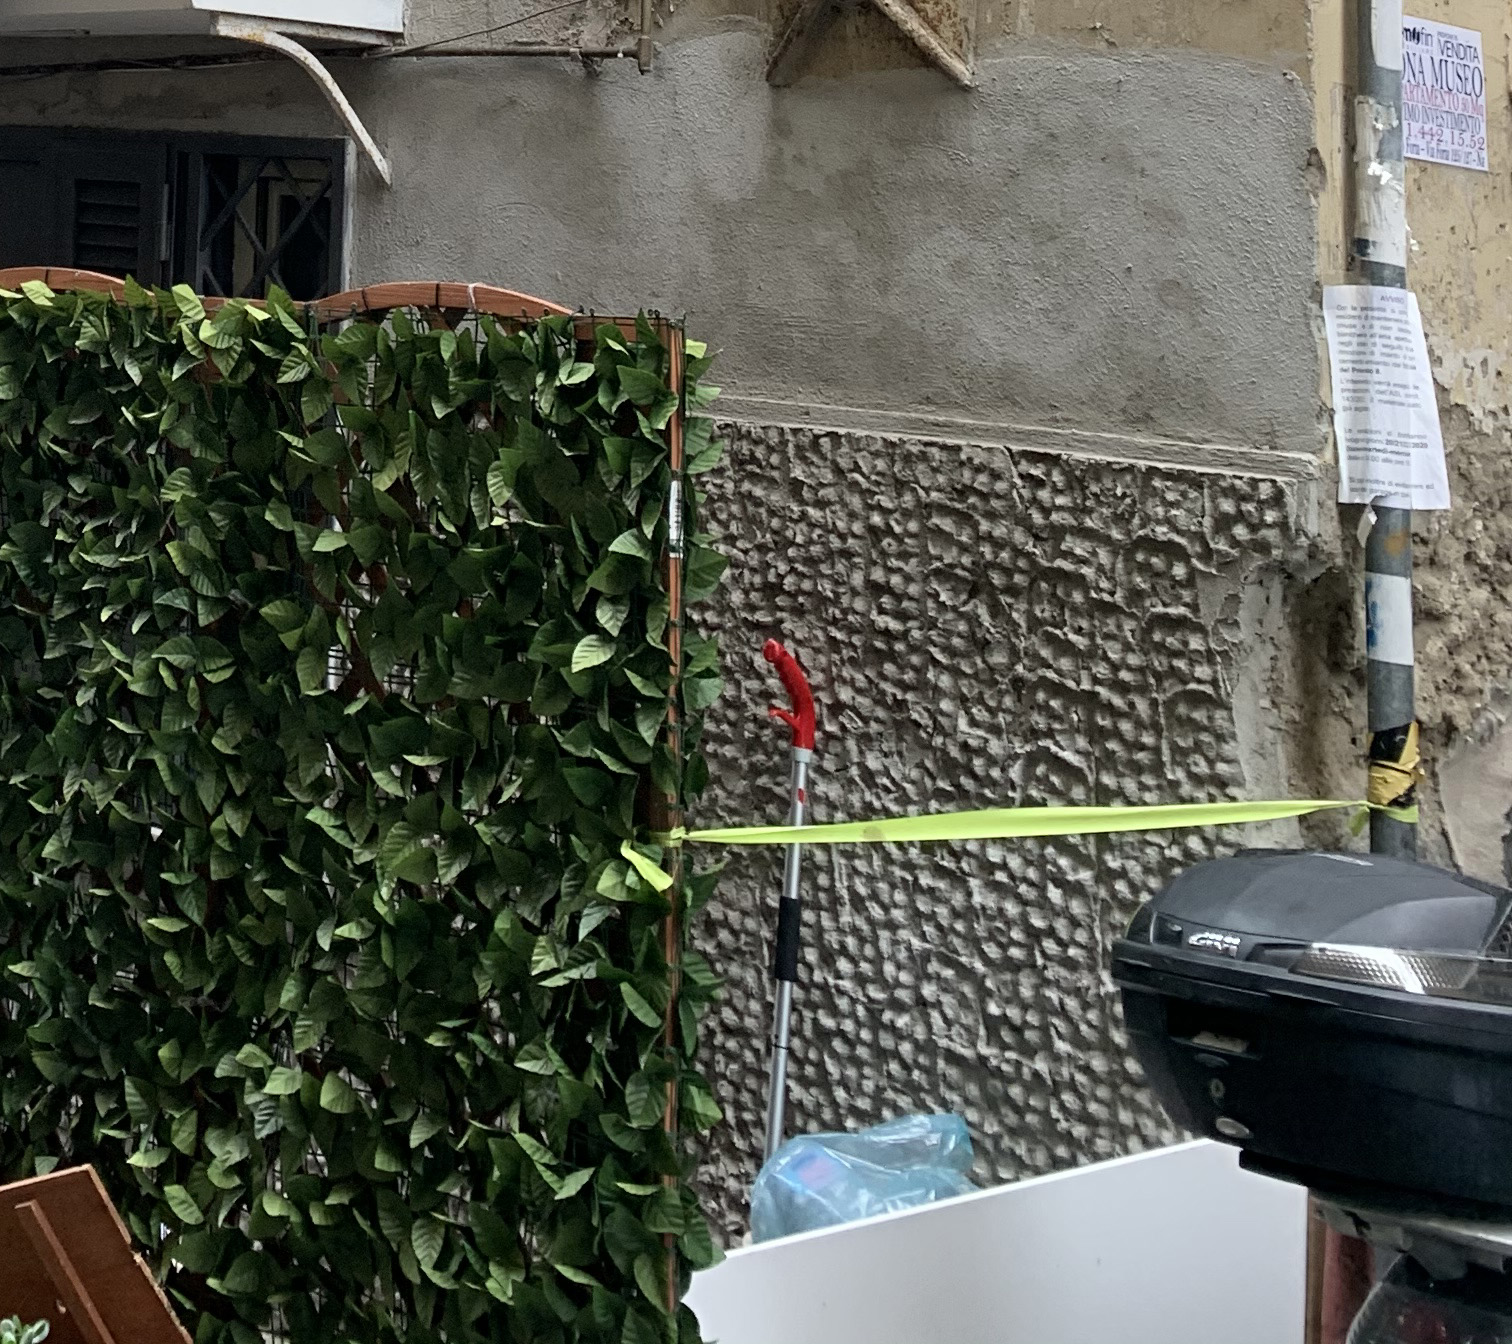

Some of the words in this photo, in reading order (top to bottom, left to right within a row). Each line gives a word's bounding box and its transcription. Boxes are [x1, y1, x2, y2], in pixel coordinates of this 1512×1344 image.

[1437, 37, 1481, 65] VENDITA
[1429, 55, 1484, 99] MUSEO
[1407, 122, 1486, 152] 1.442.15.52
